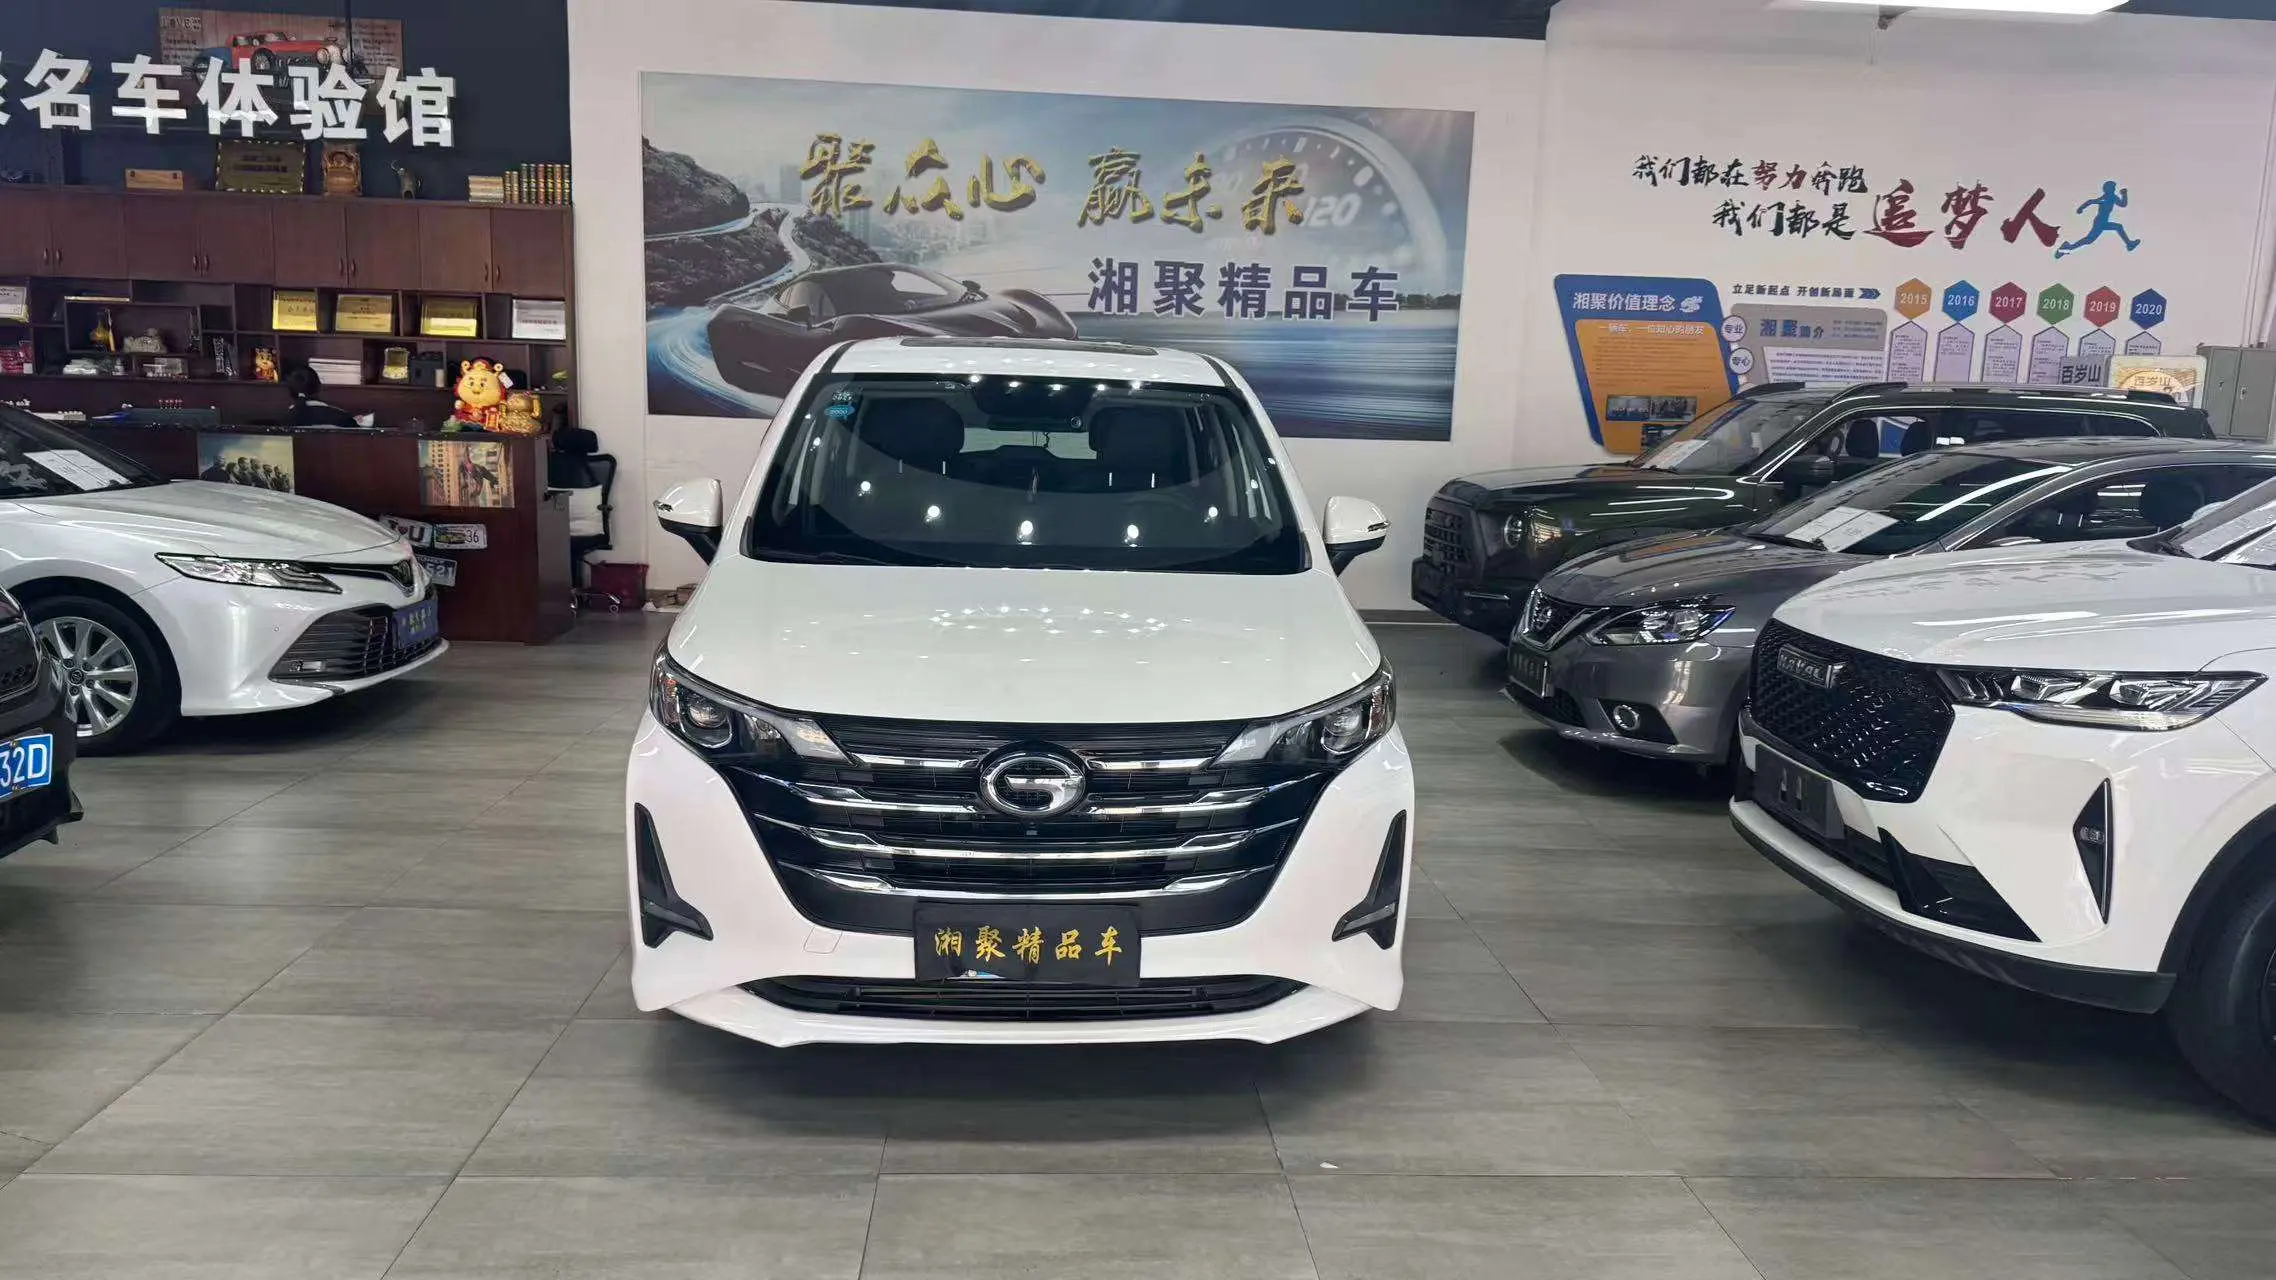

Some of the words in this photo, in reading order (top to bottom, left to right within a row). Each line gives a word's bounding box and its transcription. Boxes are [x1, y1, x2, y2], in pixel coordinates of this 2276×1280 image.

[0, 48, 455, 148] 名车体验馆
[1632, 154, 1868, 194] 我们都在努力奔跑
[801, 133, 1045, 219] 聚众心
[1078, 146, 1304, 235] 赢未来
[1087, 257, 1399, 321] 湘聚精品车
[1732, 283, 1790, 296] 立足新起点
[1797, 286, 1856, 298] 开创新局面
[1573, 292, 1676, 311] 湘聚价值理念
[1900, 293, 1928, 304] 2015
[1947, 294, 1975, 306] 2016
[1995, 296, 2023, 308] 2017
[2042, 298, 2070, 310] 2018
[2089, 301, 2116, 312] 2019
[2135, 303, 2162, 315] 2020
[2061, 363, 2102, 385] 百岁山
[2134, 375, 2171, 387] 百岁山
[0, 744, 48, 788] 32D
[934, 925, 1124, 967] 湘聚精品车
